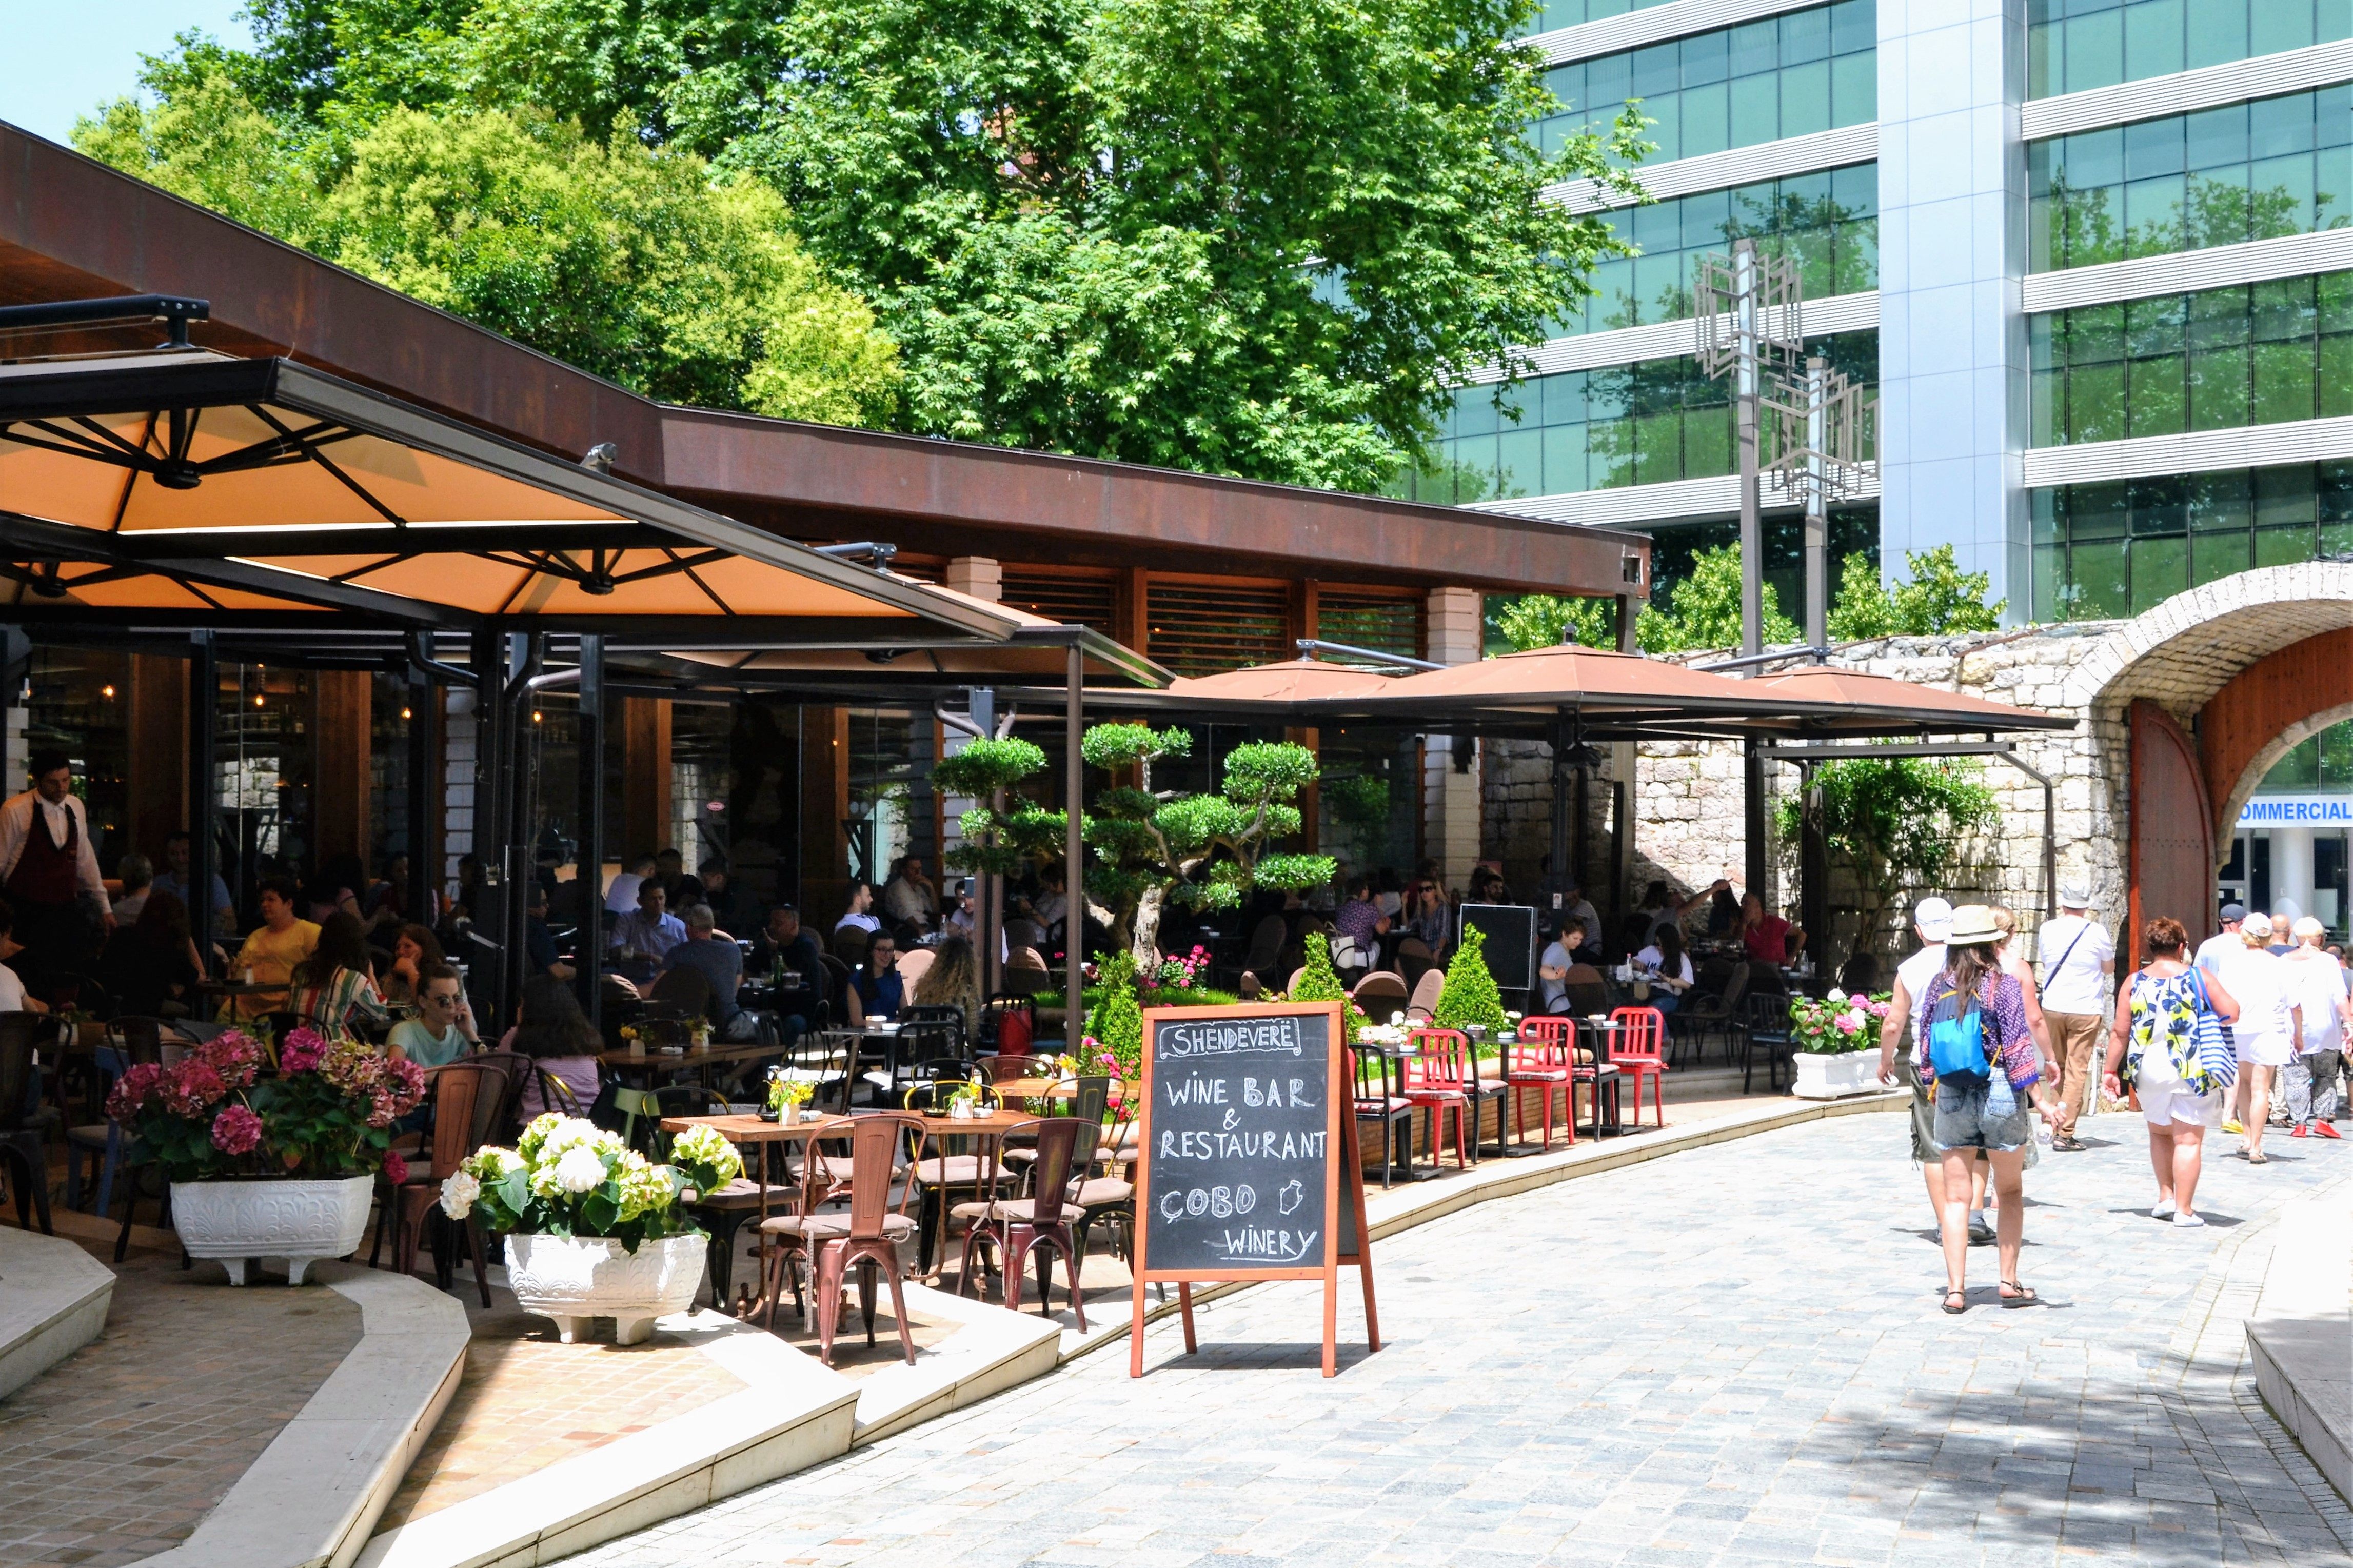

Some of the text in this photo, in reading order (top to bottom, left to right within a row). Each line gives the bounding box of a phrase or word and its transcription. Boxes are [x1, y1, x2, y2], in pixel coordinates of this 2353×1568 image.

[1243, 1077, 1315, 1108] BAR
[1222, 1108, 1241, 1130] &
[1160, 1130, 1327, 1160] RESTAURANT
